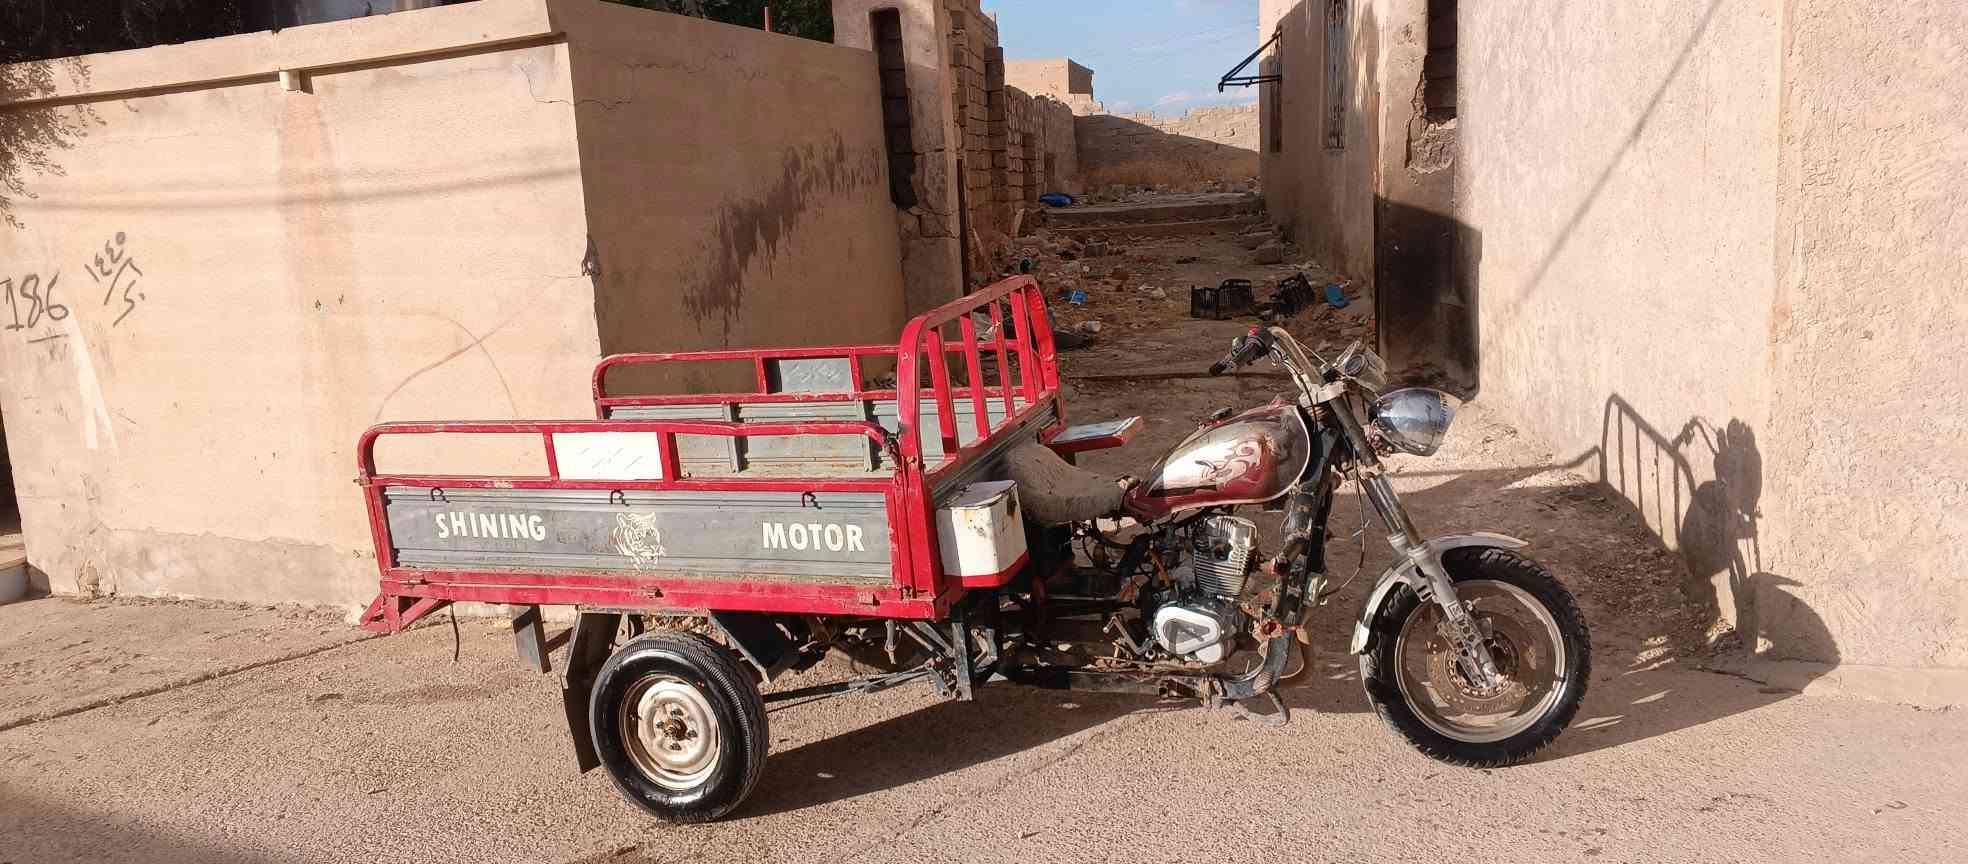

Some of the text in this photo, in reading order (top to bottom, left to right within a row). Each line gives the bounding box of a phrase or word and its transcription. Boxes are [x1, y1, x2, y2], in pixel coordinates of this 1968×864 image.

[0, 272, 69, 331] 186
[435, 511, 865, 552] SHINING MOTOR
